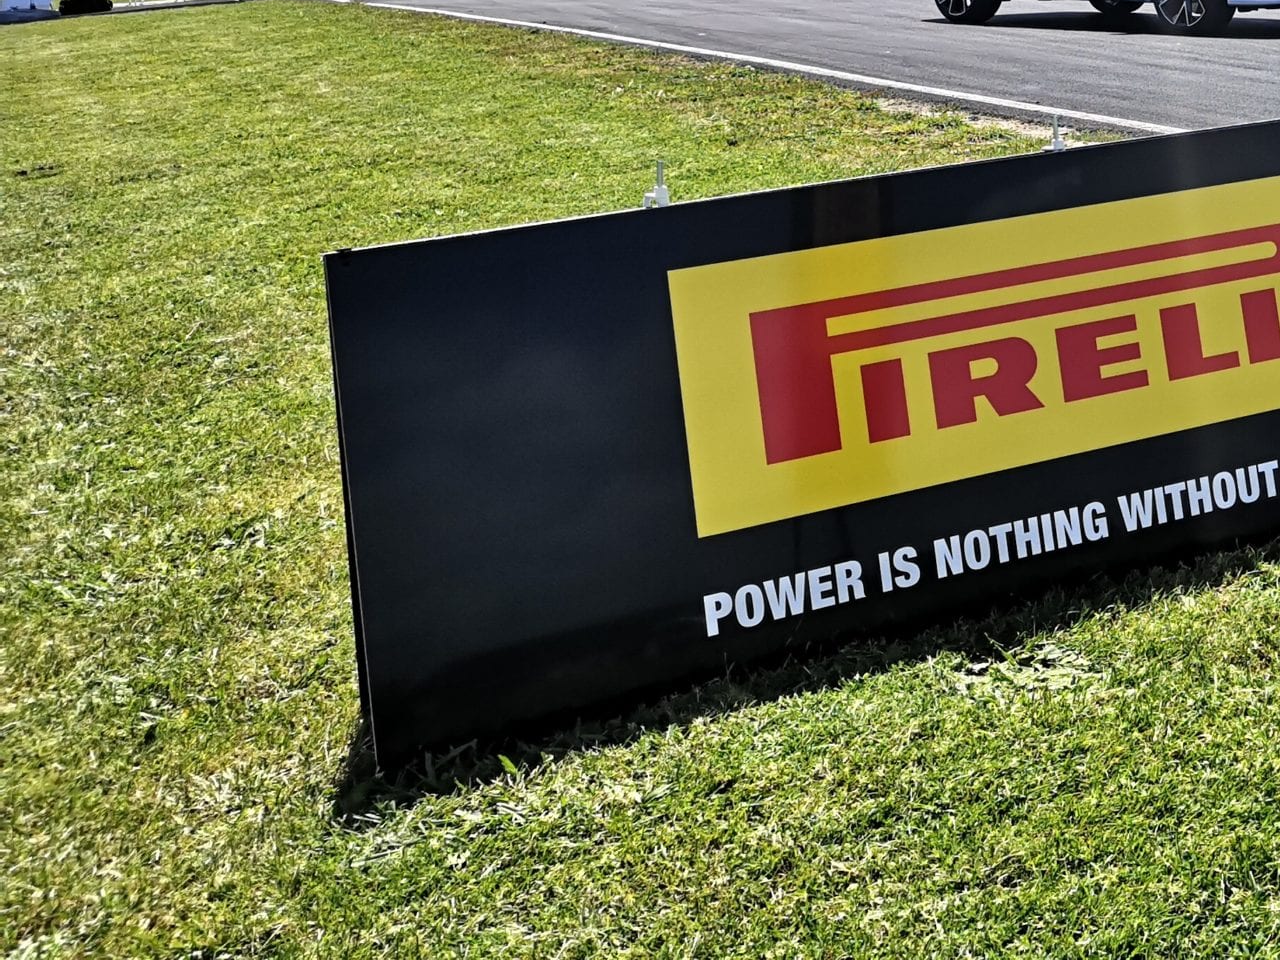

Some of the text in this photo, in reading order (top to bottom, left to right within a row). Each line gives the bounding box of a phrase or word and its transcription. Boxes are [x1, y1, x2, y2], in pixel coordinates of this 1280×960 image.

[703, 559, 866, 638] POWER
[879, 546, 921, 593] IS
[934, 500, 1110, 580] NOTHING
[1117, 460, 1279, 532] WITHOUT
